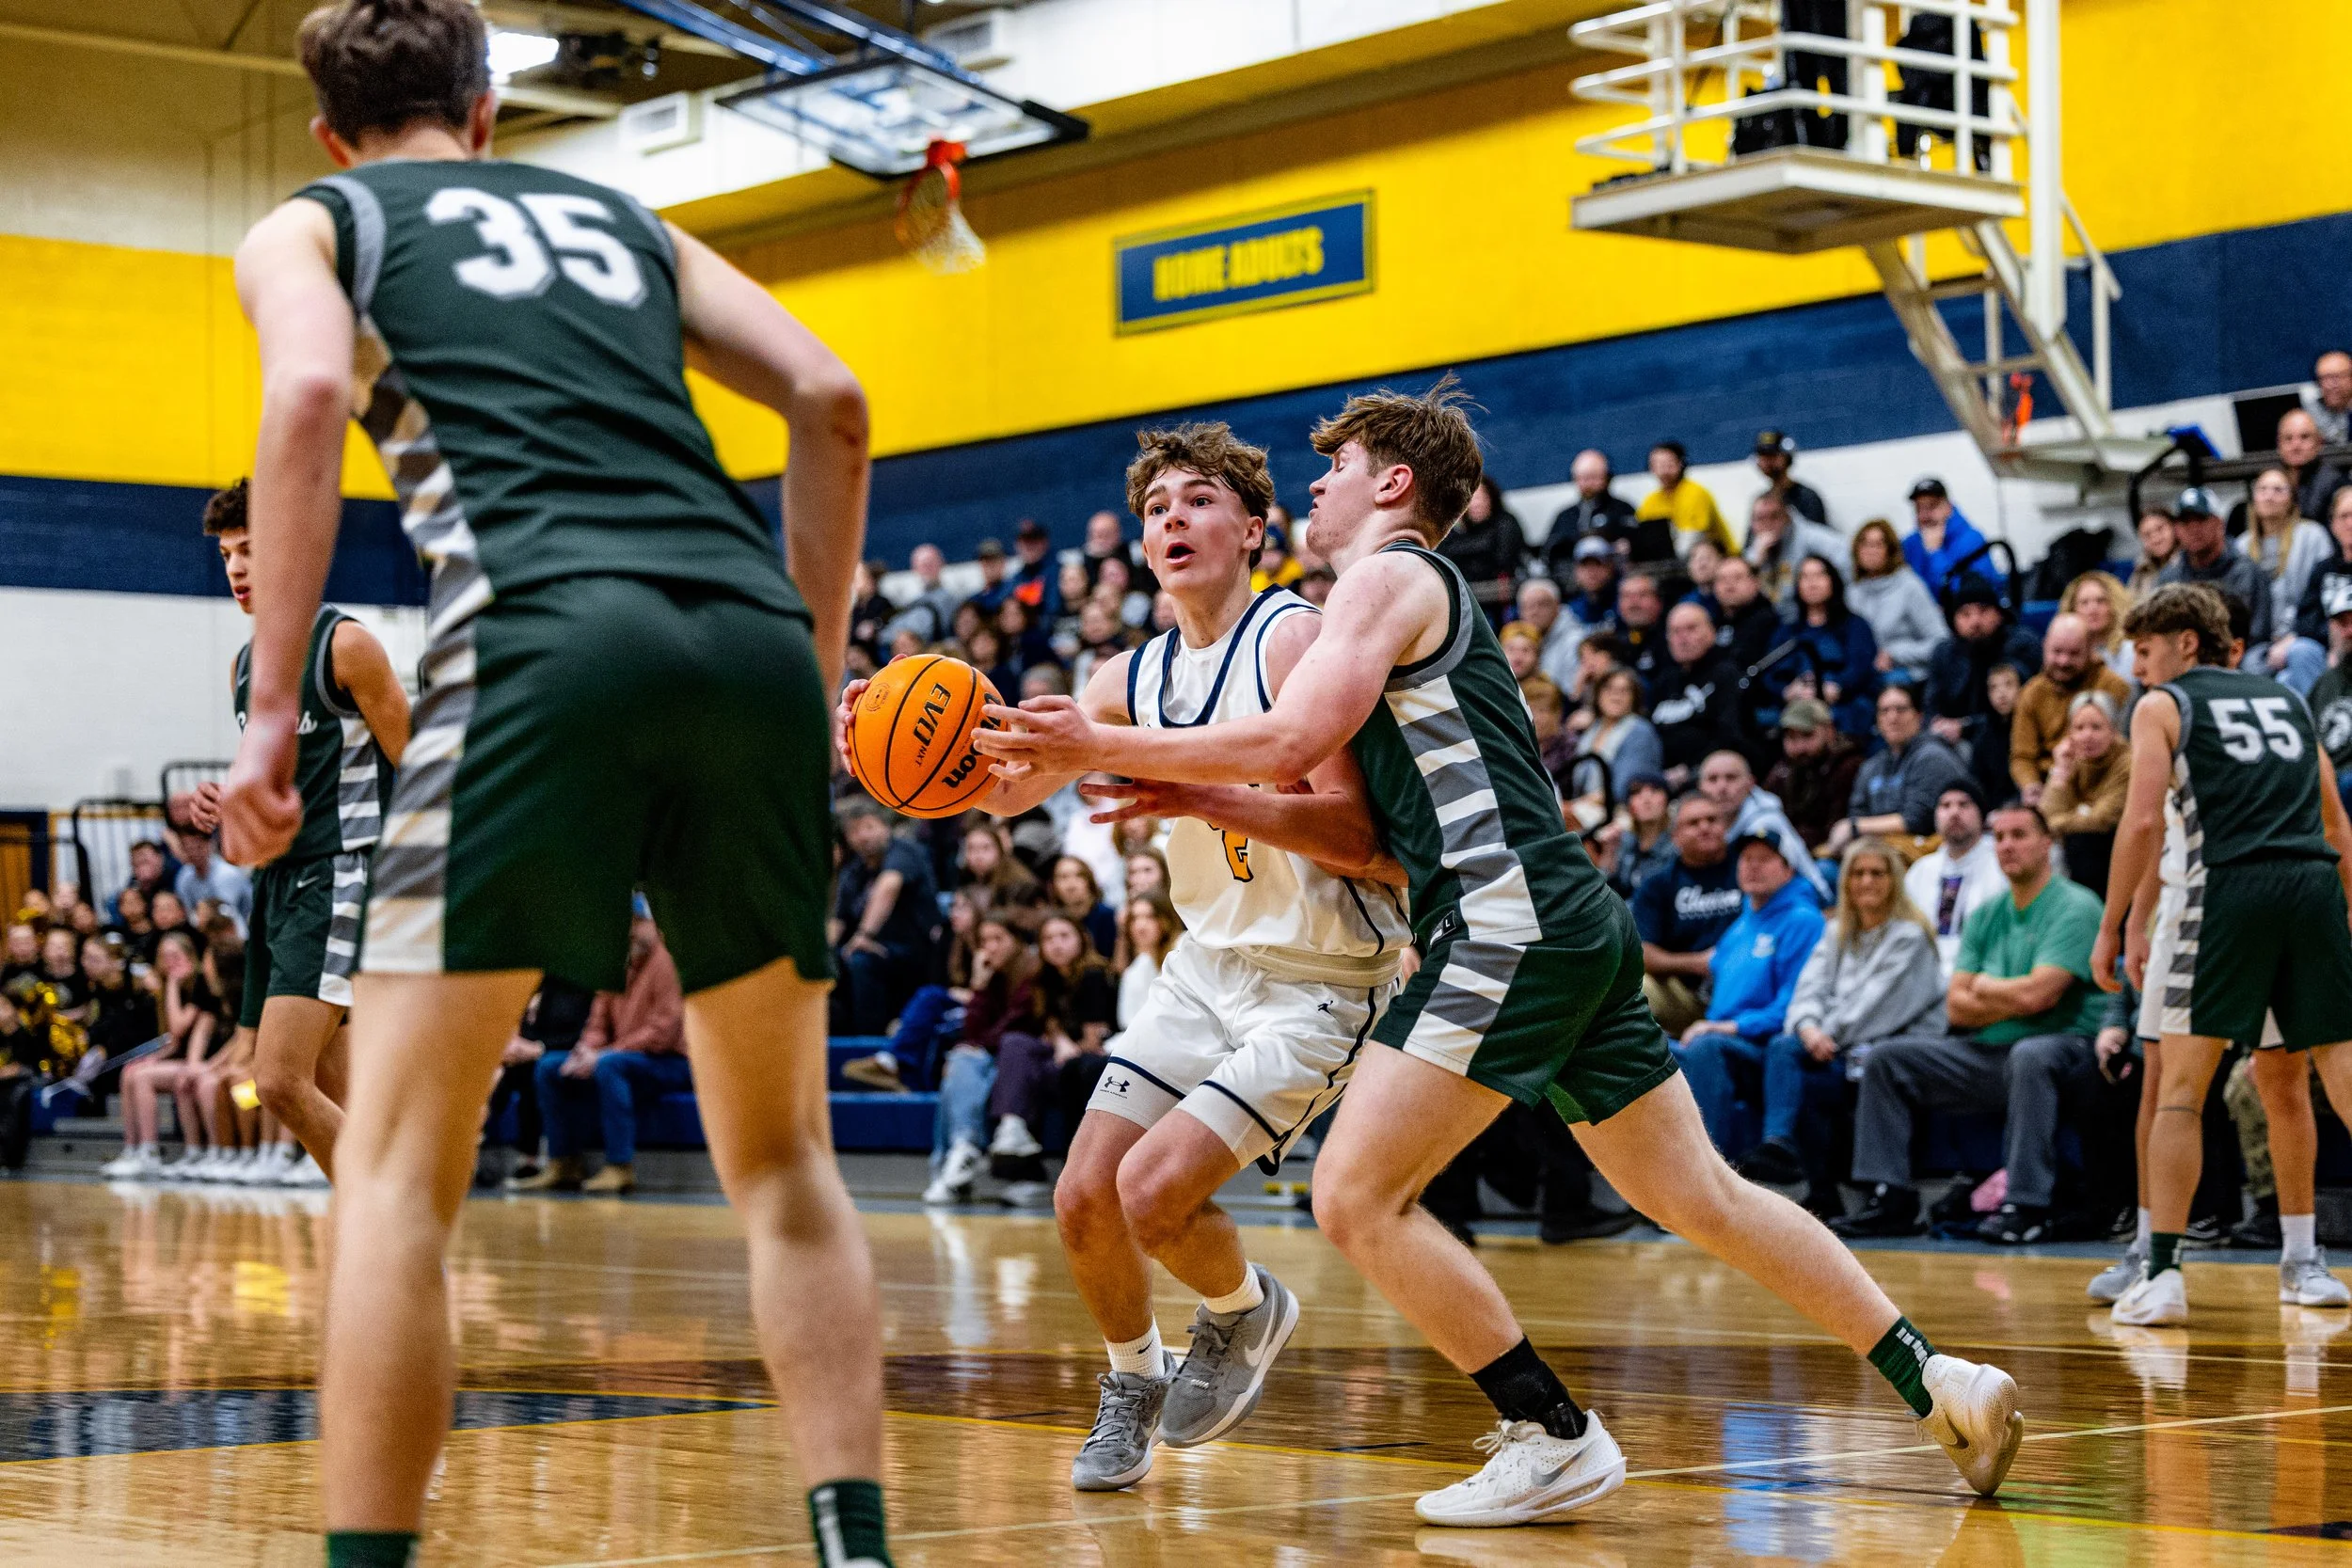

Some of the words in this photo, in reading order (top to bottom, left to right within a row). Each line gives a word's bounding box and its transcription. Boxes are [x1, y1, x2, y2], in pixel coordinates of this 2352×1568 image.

[425, 188, 646, 309] 35
[913, 682, 952, 747] EVO
[2208, 697, 2303, 763] 55
[915, 747, 928, 768] NXT
